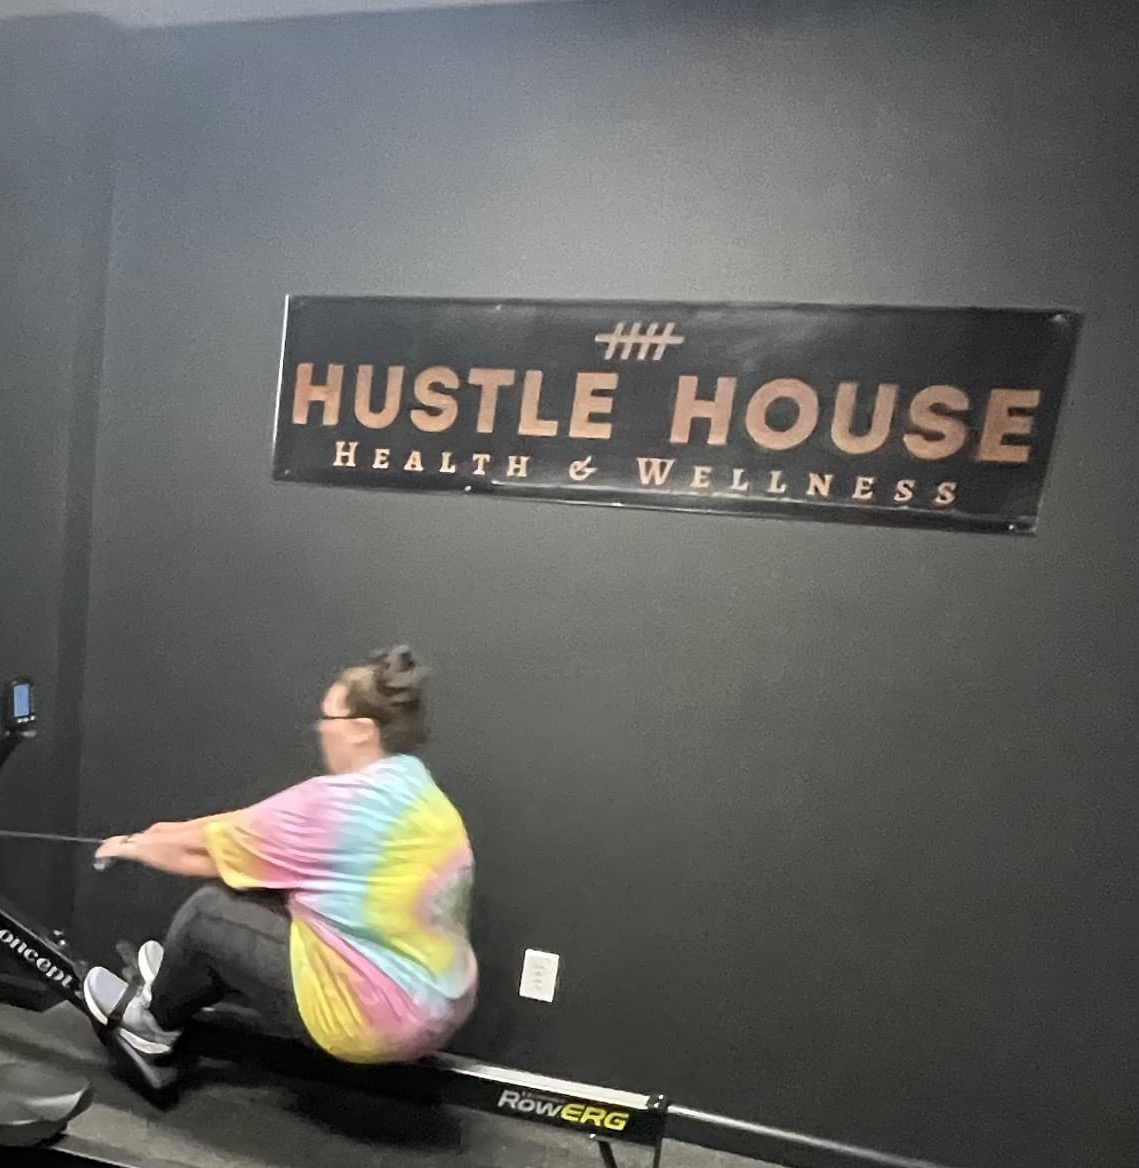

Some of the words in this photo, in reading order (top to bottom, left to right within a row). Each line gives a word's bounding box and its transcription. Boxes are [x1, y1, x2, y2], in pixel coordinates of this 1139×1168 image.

[292, 362, 618, 440] HUSTLE
[669, 375, 1041, 463] HOUSE
[333, 441, 531, 477] HEALTH
[568, 456, 598, 481] &
[636, 457, 957, 505] WELLNESS
